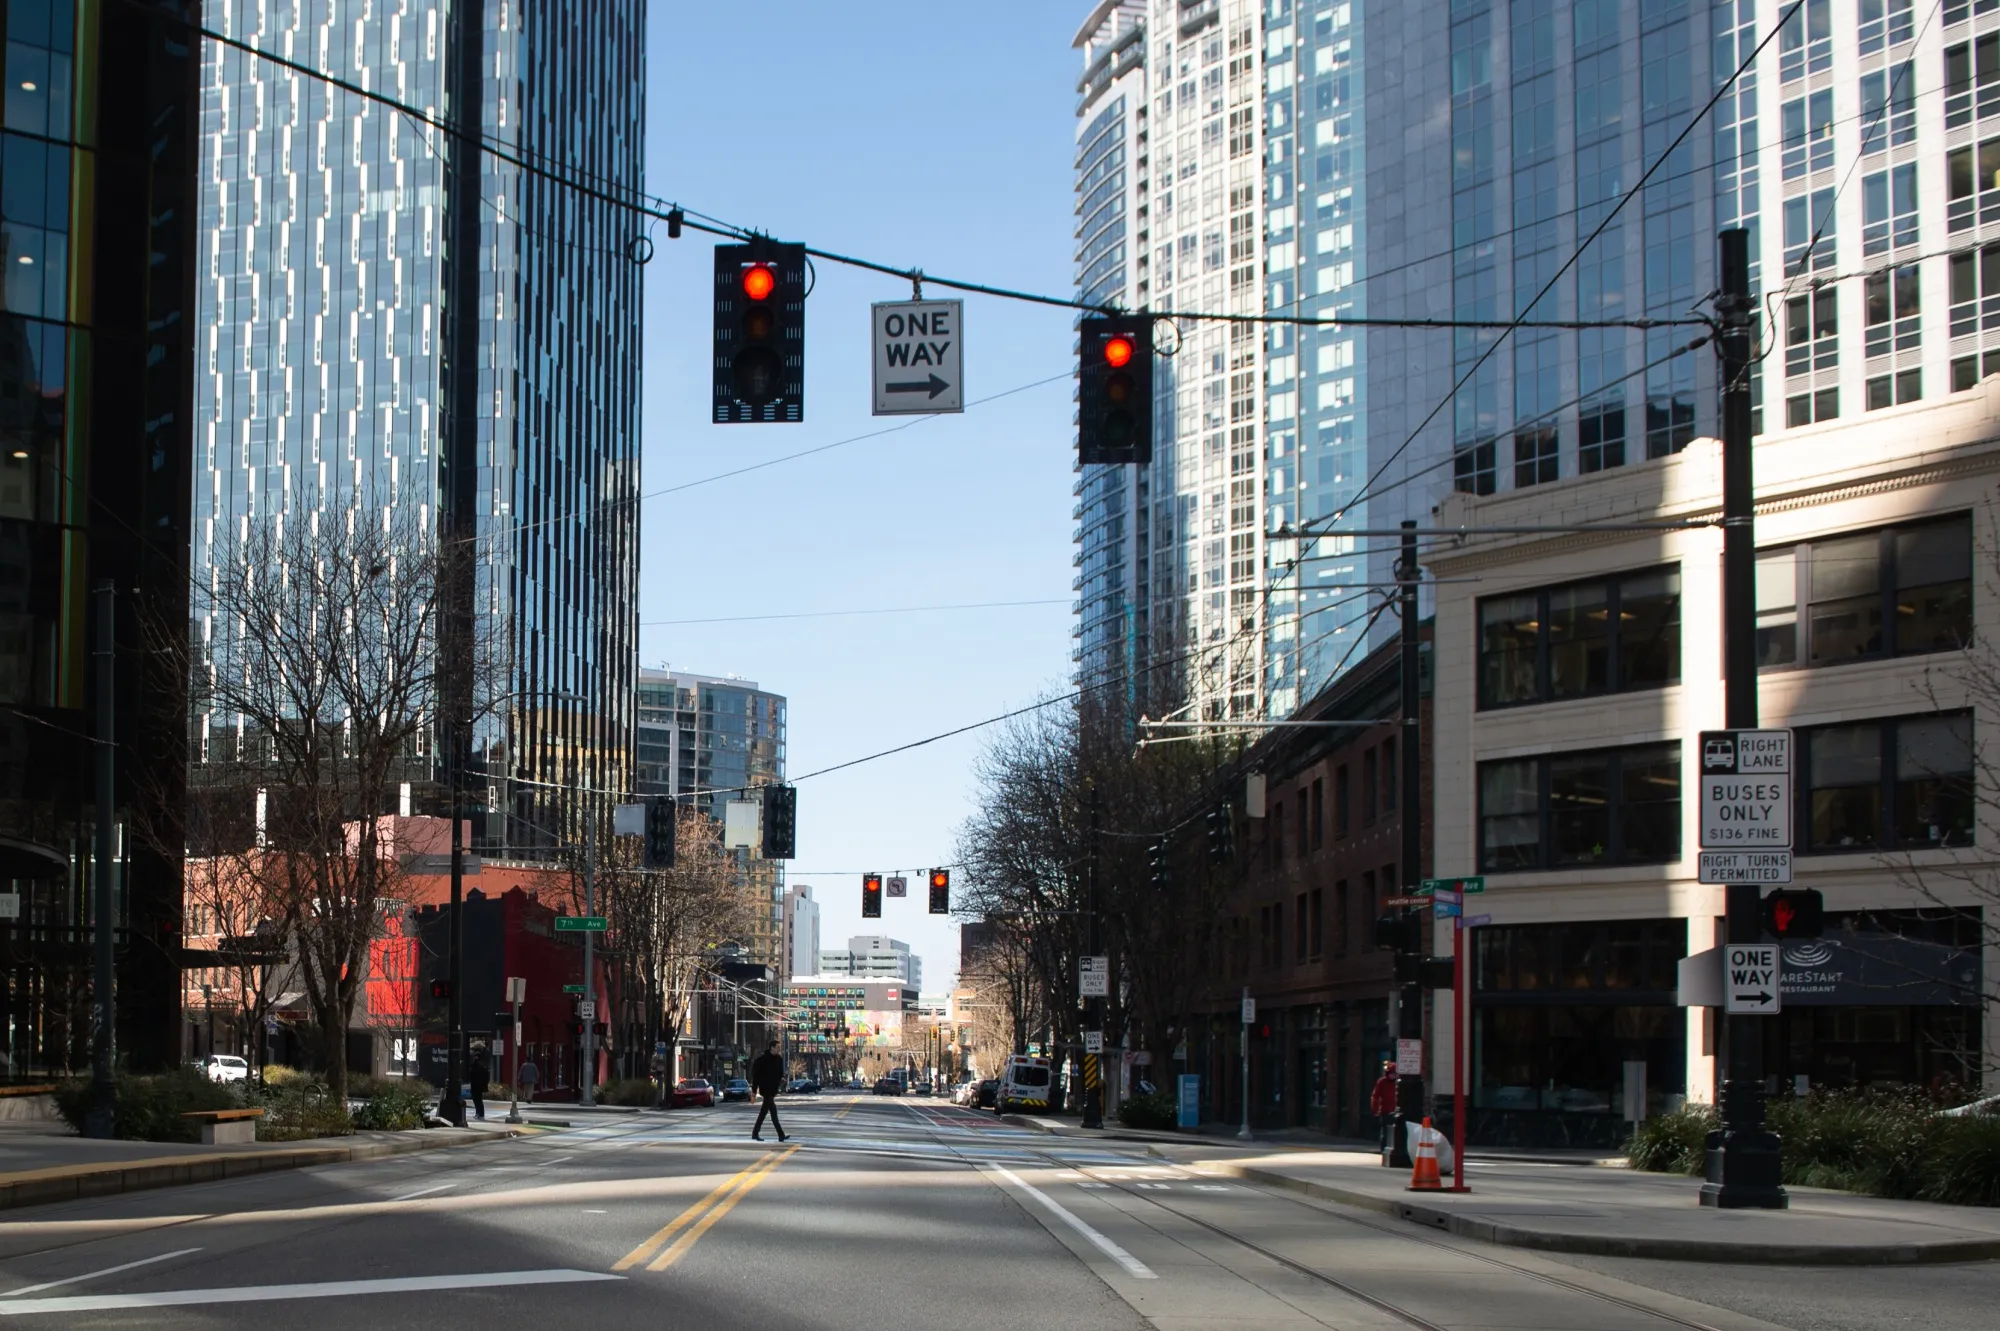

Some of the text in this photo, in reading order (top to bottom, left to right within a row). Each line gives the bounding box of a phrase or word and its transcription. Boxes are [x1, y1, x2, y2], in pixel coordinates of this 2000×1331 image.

[885, 311, 950, 338] ONE
[885, 341, 951, 368] WAY
[1740, 739, 1786, 752] RIGHT
[1743, 755, 1783, 767] LANE
[1712, 785, 1780, 801] BUSES
[1719, 805, 1773, 821] ONLY
[1709, 828, 1779, 839] $136 FINE
[1702, 854, 1787, 867] RIGHT TURNS
[1711, 868, 1779, 880] PERMITTED
[1463, 881, 1479, 890] Ave
[1388, 897, 1409, 905] seattle
[1731, 950, 1772, 966] ONE
[1731, 970, 1774, 985] WAY
[1779, 985, 1836, 994] RESTAURANT
